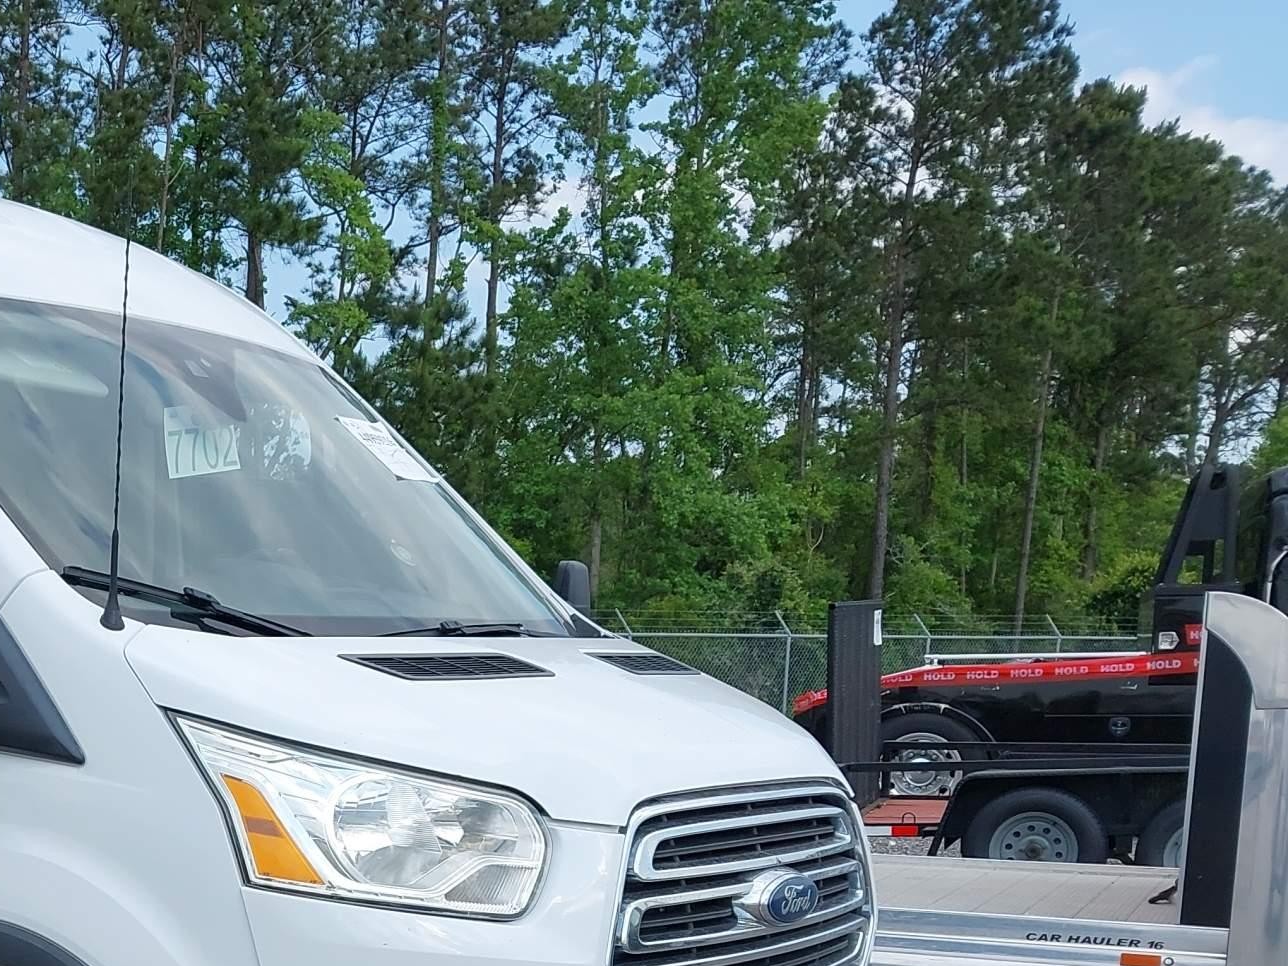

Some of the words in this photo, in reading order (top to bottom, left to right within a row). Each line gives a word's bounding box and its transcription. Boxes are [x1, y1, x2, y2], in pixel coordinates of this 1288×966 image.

[167, 428, 238, 475] 7702
[923, 671, 956, 682] HOLD
[966, 669, 999, 680] HOLD
[1011, 668, 1044, 678] HOLD
[1055, 665, 1089, 675] HOLD
[1100, 662, 1135, 673] HOLD
[1147, 659, 1181, 670] HOLD
[781, 884, 811, 915] Ford
[1025, 932, 1062, 943] CAR
[1067, 935, 1142, 948] HAULER
[1147, 940, 1165, 950] 16
